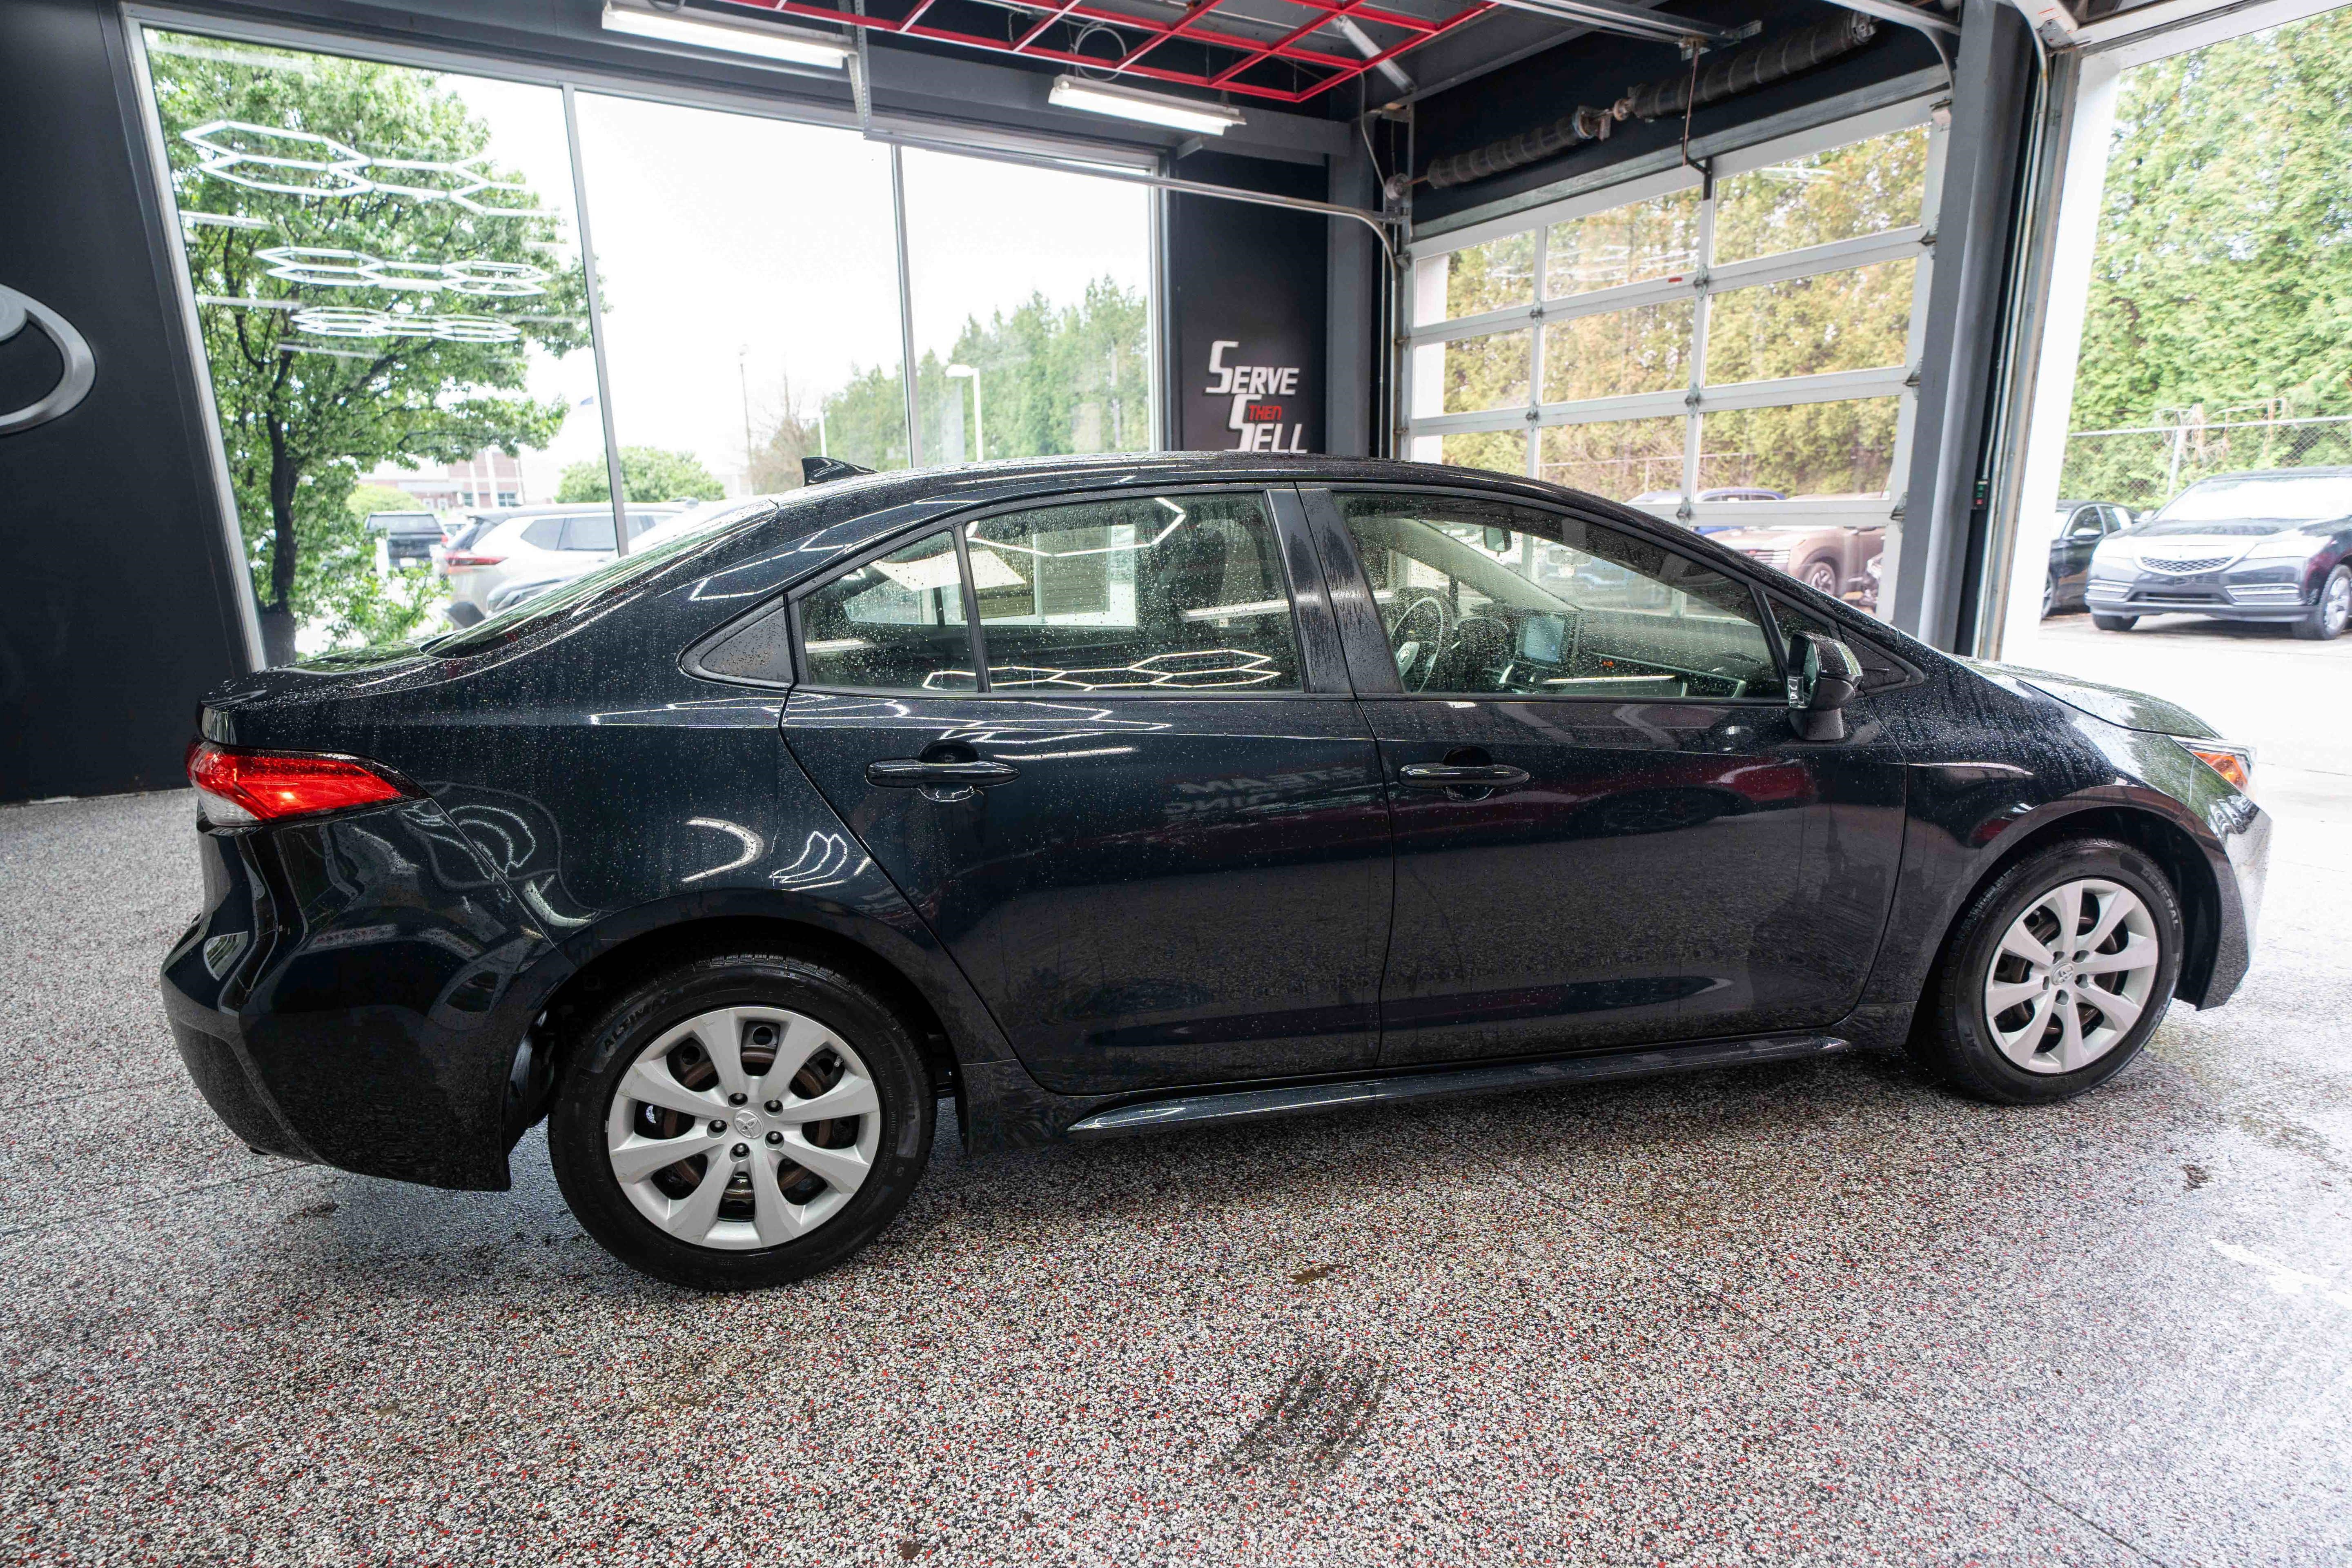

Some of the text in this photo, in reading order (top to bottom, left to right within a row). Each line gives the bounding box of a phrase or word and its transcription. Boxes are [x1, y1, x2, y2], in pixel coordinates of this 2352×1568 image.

[1205, 340, 1300, 395] SERVE
[1225, 393, 1307, 453] SELL
[1249, 405, 1282, 420] THEN
[2140, 868, 2179, 930] GENERAL
